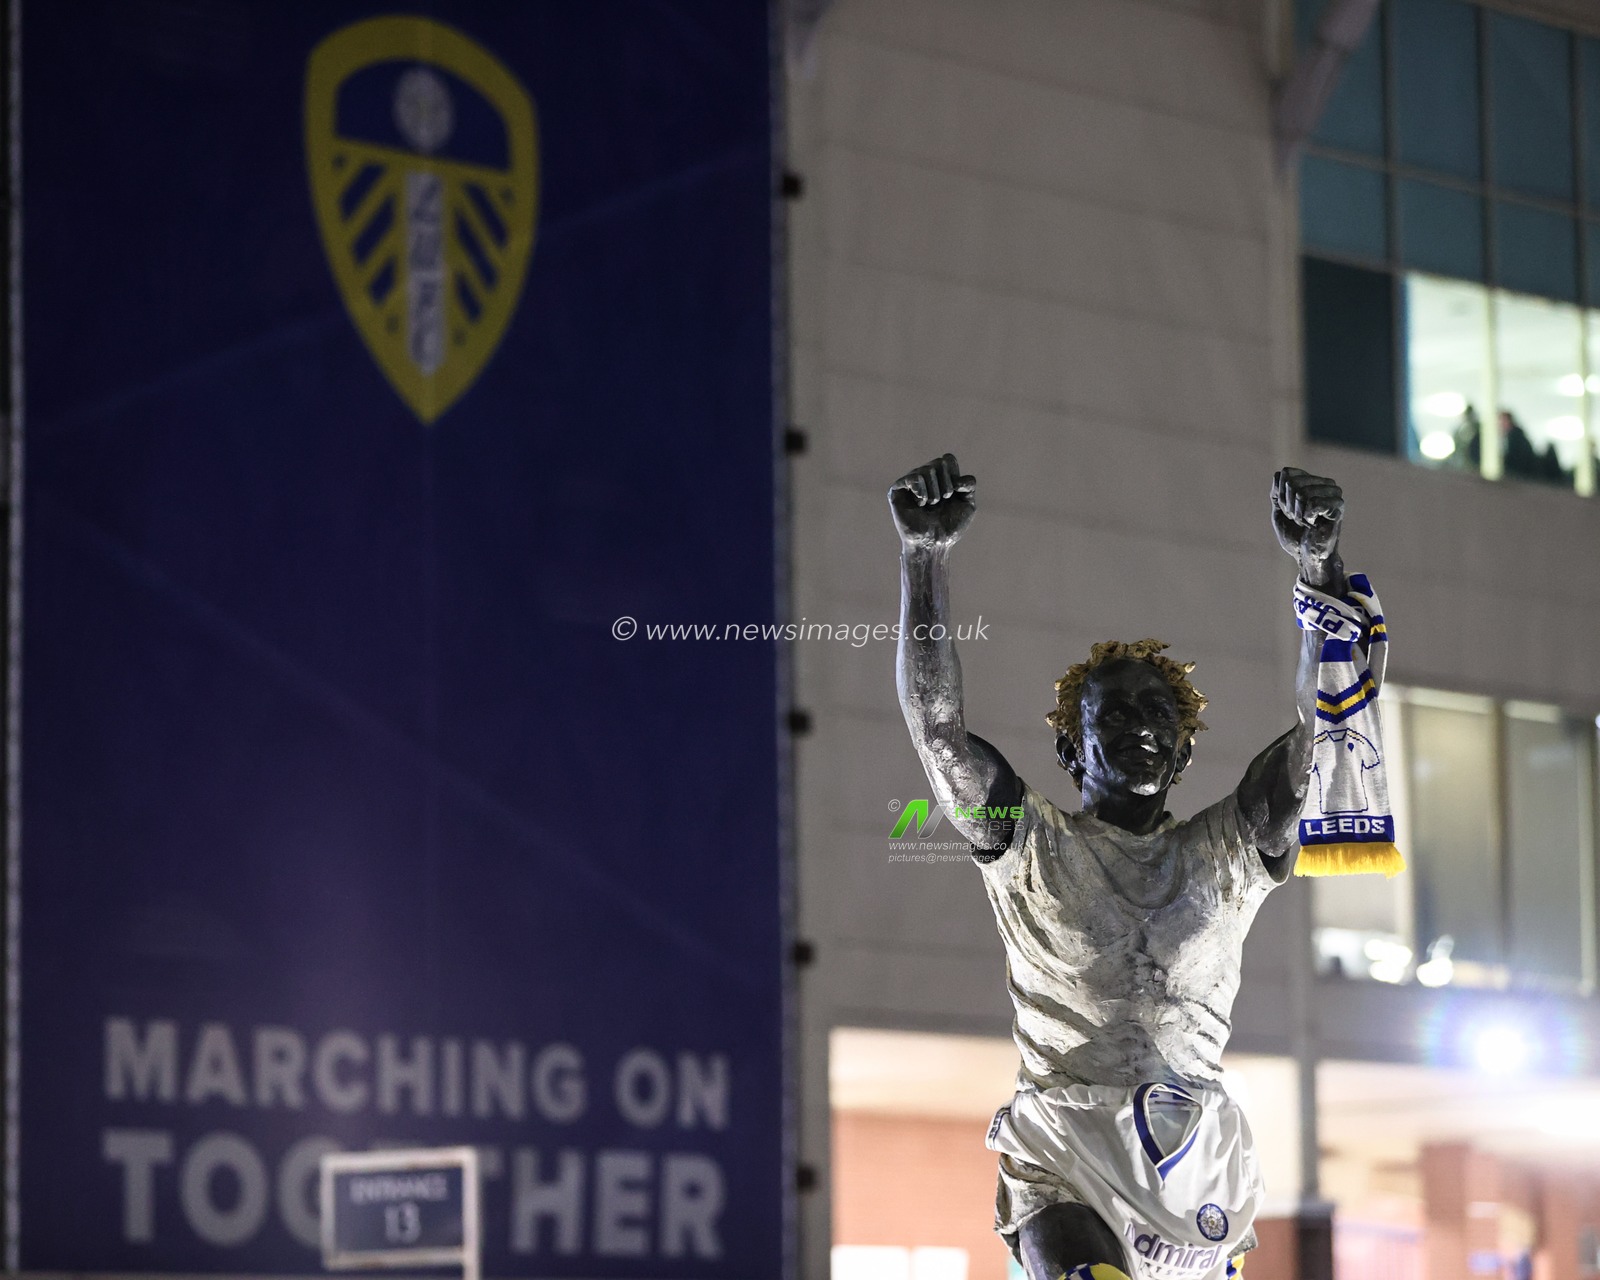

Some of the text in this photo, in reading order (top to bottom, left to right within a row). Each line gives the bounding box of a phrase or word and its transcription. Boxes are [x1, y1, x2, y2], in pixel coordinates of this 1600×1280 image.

[1304, 818, 1386, 836] LEEDS
[103, 1018, 730, 1131] MARCHING ON
[384, 1201, 422, 1243] 13
